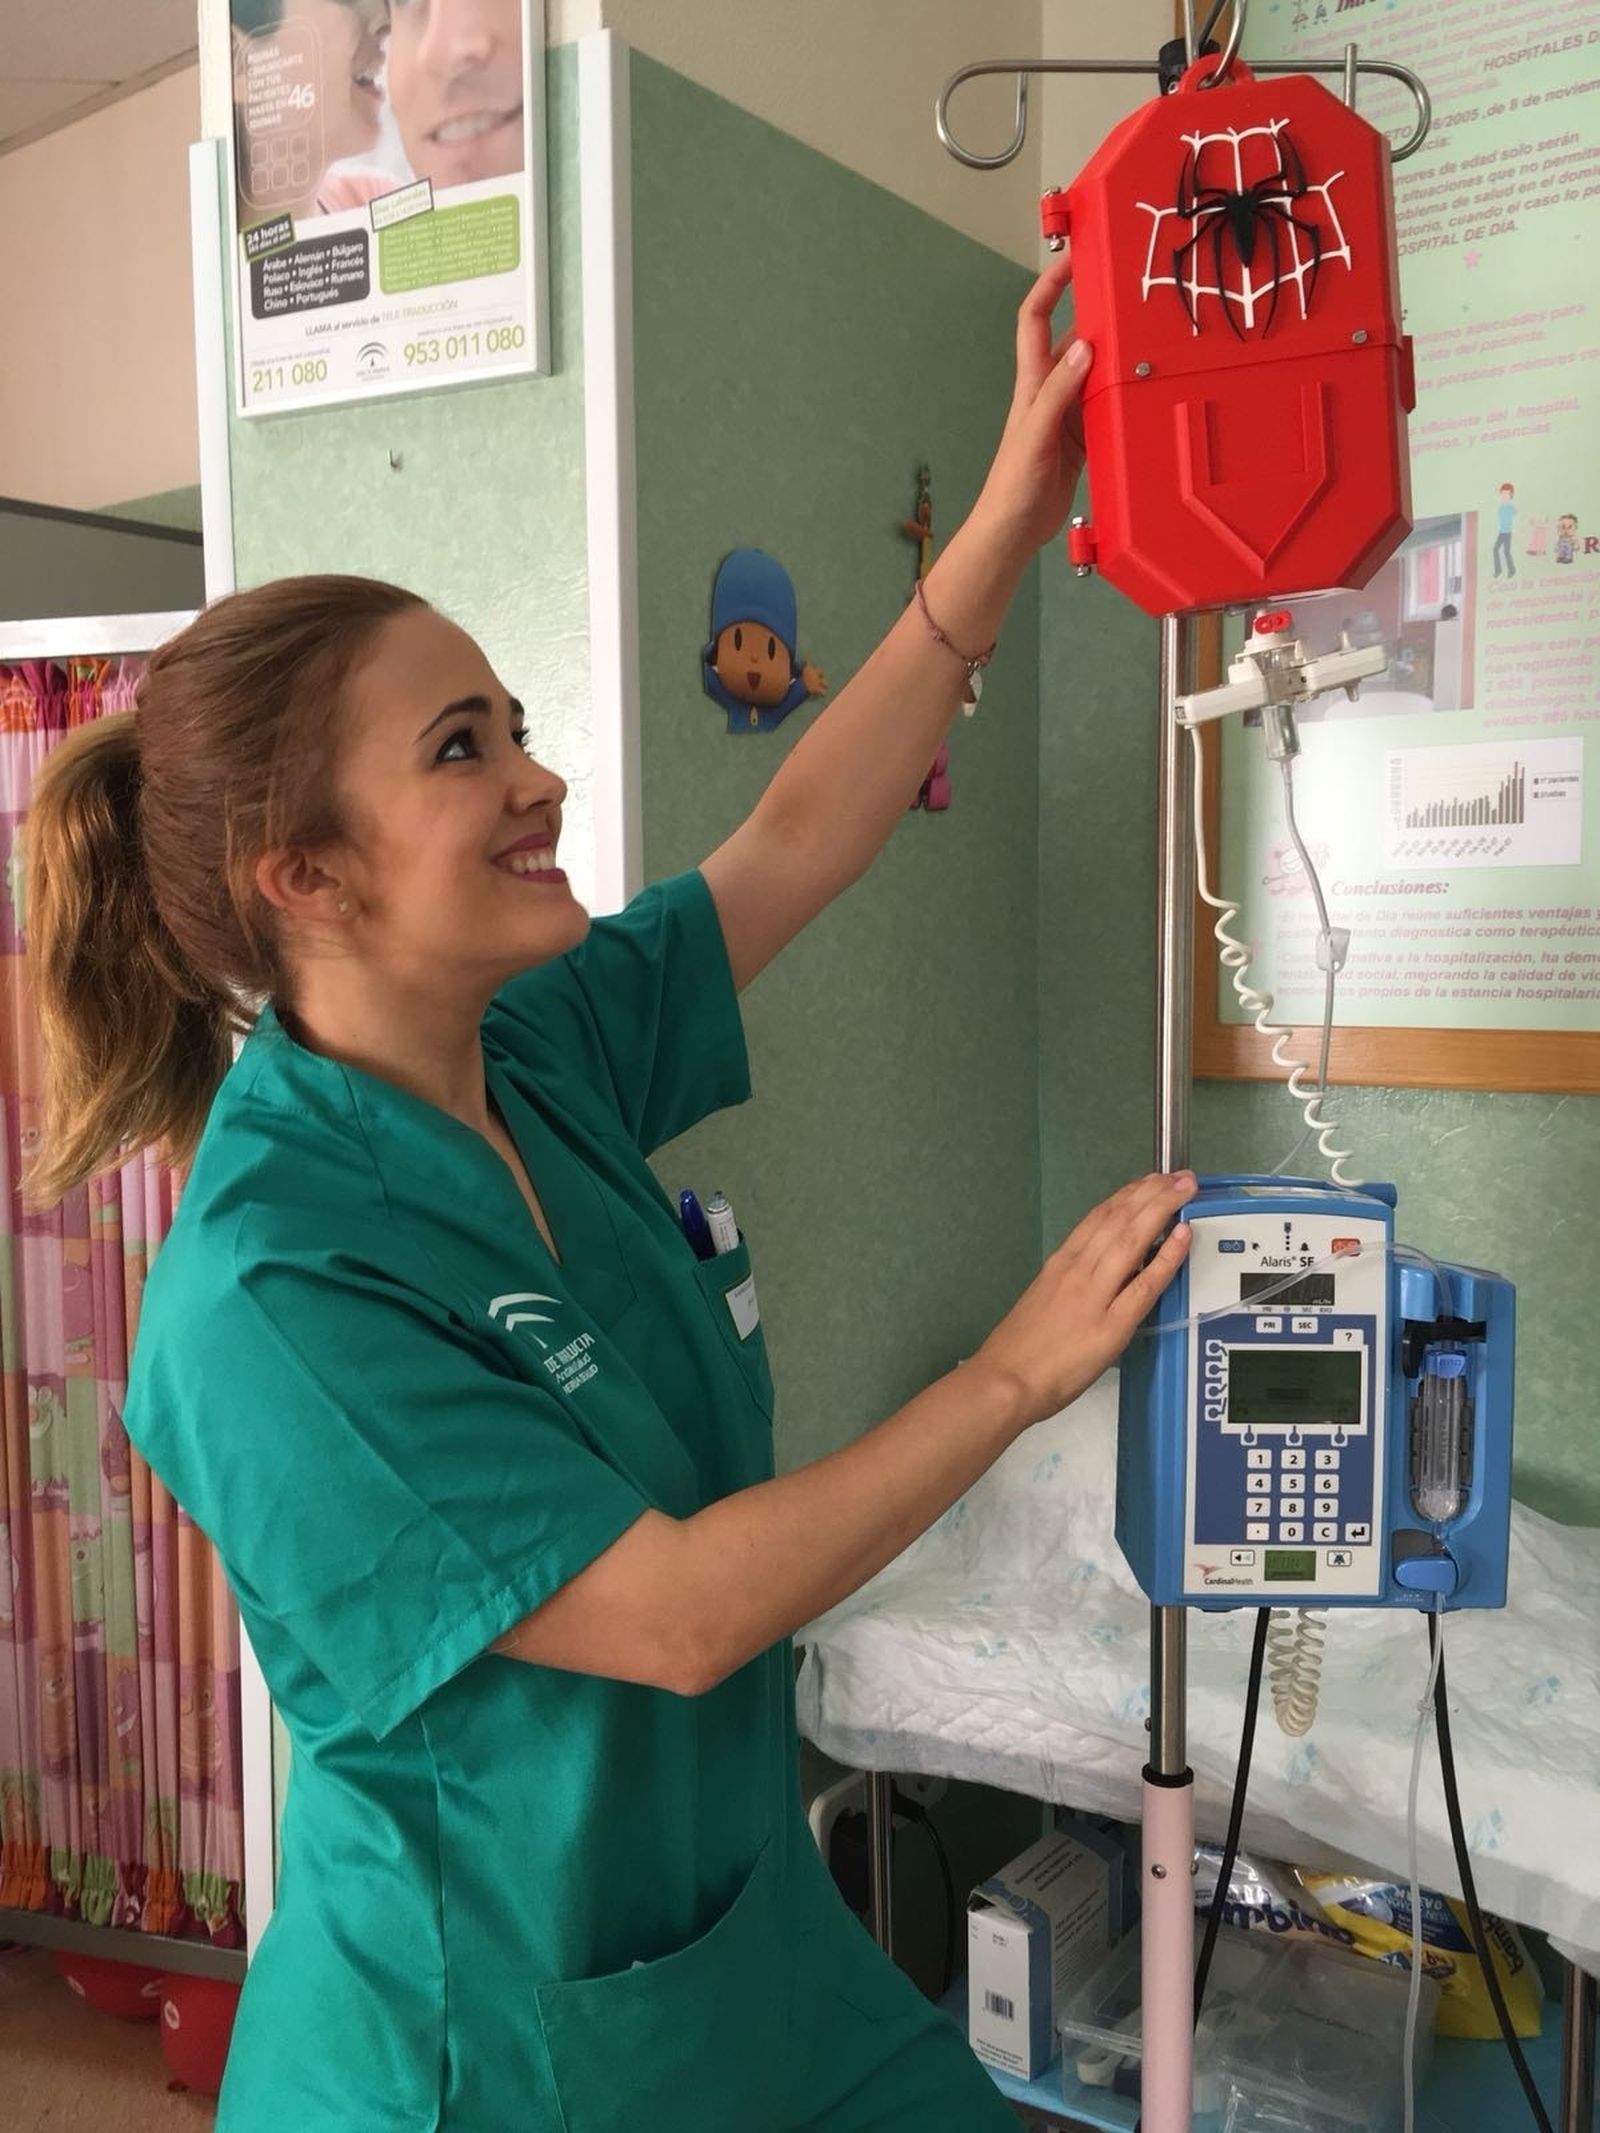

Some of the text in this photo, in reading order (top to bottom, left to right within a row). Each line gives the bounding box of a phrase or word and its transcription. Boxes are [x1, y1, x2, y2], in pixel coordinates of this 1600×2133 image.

[1484, 34, 1584, 72] HOSPITALES
[1587, 30, 1600, 44] D
[288, 83, 316, 111] 46
[1522, 93, 1541, 108] de
[1440, 160, 1457, 176] de
[1461, 152, 1498, 171] edad
[1538, 131, 1579, 153] serán
[1402, 146, 1600, 204] situaciones que no permita
[1397, 201, 1448, 223] oblema
[1452, 194, 1470, 209] de
[1473, 183, 1515, 205] salud
[1518, 180, 1537, 194] en
[1448, 204, 1504, 227] cuando
[1524, 193, 1561, 211] caso
[261, 221, 291, 240] horas
[1397, 233, 1460, 257] OSPITAL
[1463, 226, 1486, 243] DE
[294, 250, 326, 265] Alemán
[263, 272, 291, 286] Polaco
[331, 256, 365, 271] Francés
[263, 270, 365, 299] Ruso Eslovaco Rumano
[263, 288, 339, 312] Chino Portugués
[305, 321, 332, 337] LLAMA
[370, 313, 381, 325] de
[402, 299, 459, 319] TRADUCCIÓN
[403, 338, 441, 367] 953
[445, 332, 481, 360] 011
[486, 324, 526, 353] 080
[252, 366, 284, 393] 211
[291, 358, 328, 385] 080
[1583, 535, 1600, 555] R
[1331, 879, 1450, 897] Conclusiones:
[1445, 907, 1524, 921] suficientes
[1528, 906, 1592, 922] ventajas
[1475, 927, 1516, 938] como
[1424, 951, 1536, 965] hospitalización,
[1541, 951, 1560, 964] ha
[1404, 969, 1480, 983] mejorando
[1484, 969, 1496, 981] la
[1500, 968, 1554, 981] calidad
[1558, 969, 1577, 981] de
[1358, 985, 1411, 998] propios
[1414, 986, 1432, 998] de
[1435, 986, 1447, 998] la
[1451, 987, 1512, 999] estancia
[1516, 986, 1600, 1001] hospitalari
[1263, 1321, 1313, 1329] PRI SEC
[1345, 1332, 1353, 1342] ?
[1257, 1454, 1263, 1464] 1
[1290, 1454, 1298, 1464] 2
[1324, 1454, 1332, 1464] 3
[1255, 1478, 1264, 1489] 4
[1289, 1478, 1297, 1489] 5
[1323, 1478, 1331, 1489] 6
[1255, 1502, 1263, 1513] 7
[1288, 1502, 1297, 1513] 8
[1322, 1502, 1331, 1513] 9
[1287, 1527, 1296, 1537] 0
[1321, 1527, 1330, 1537] C
